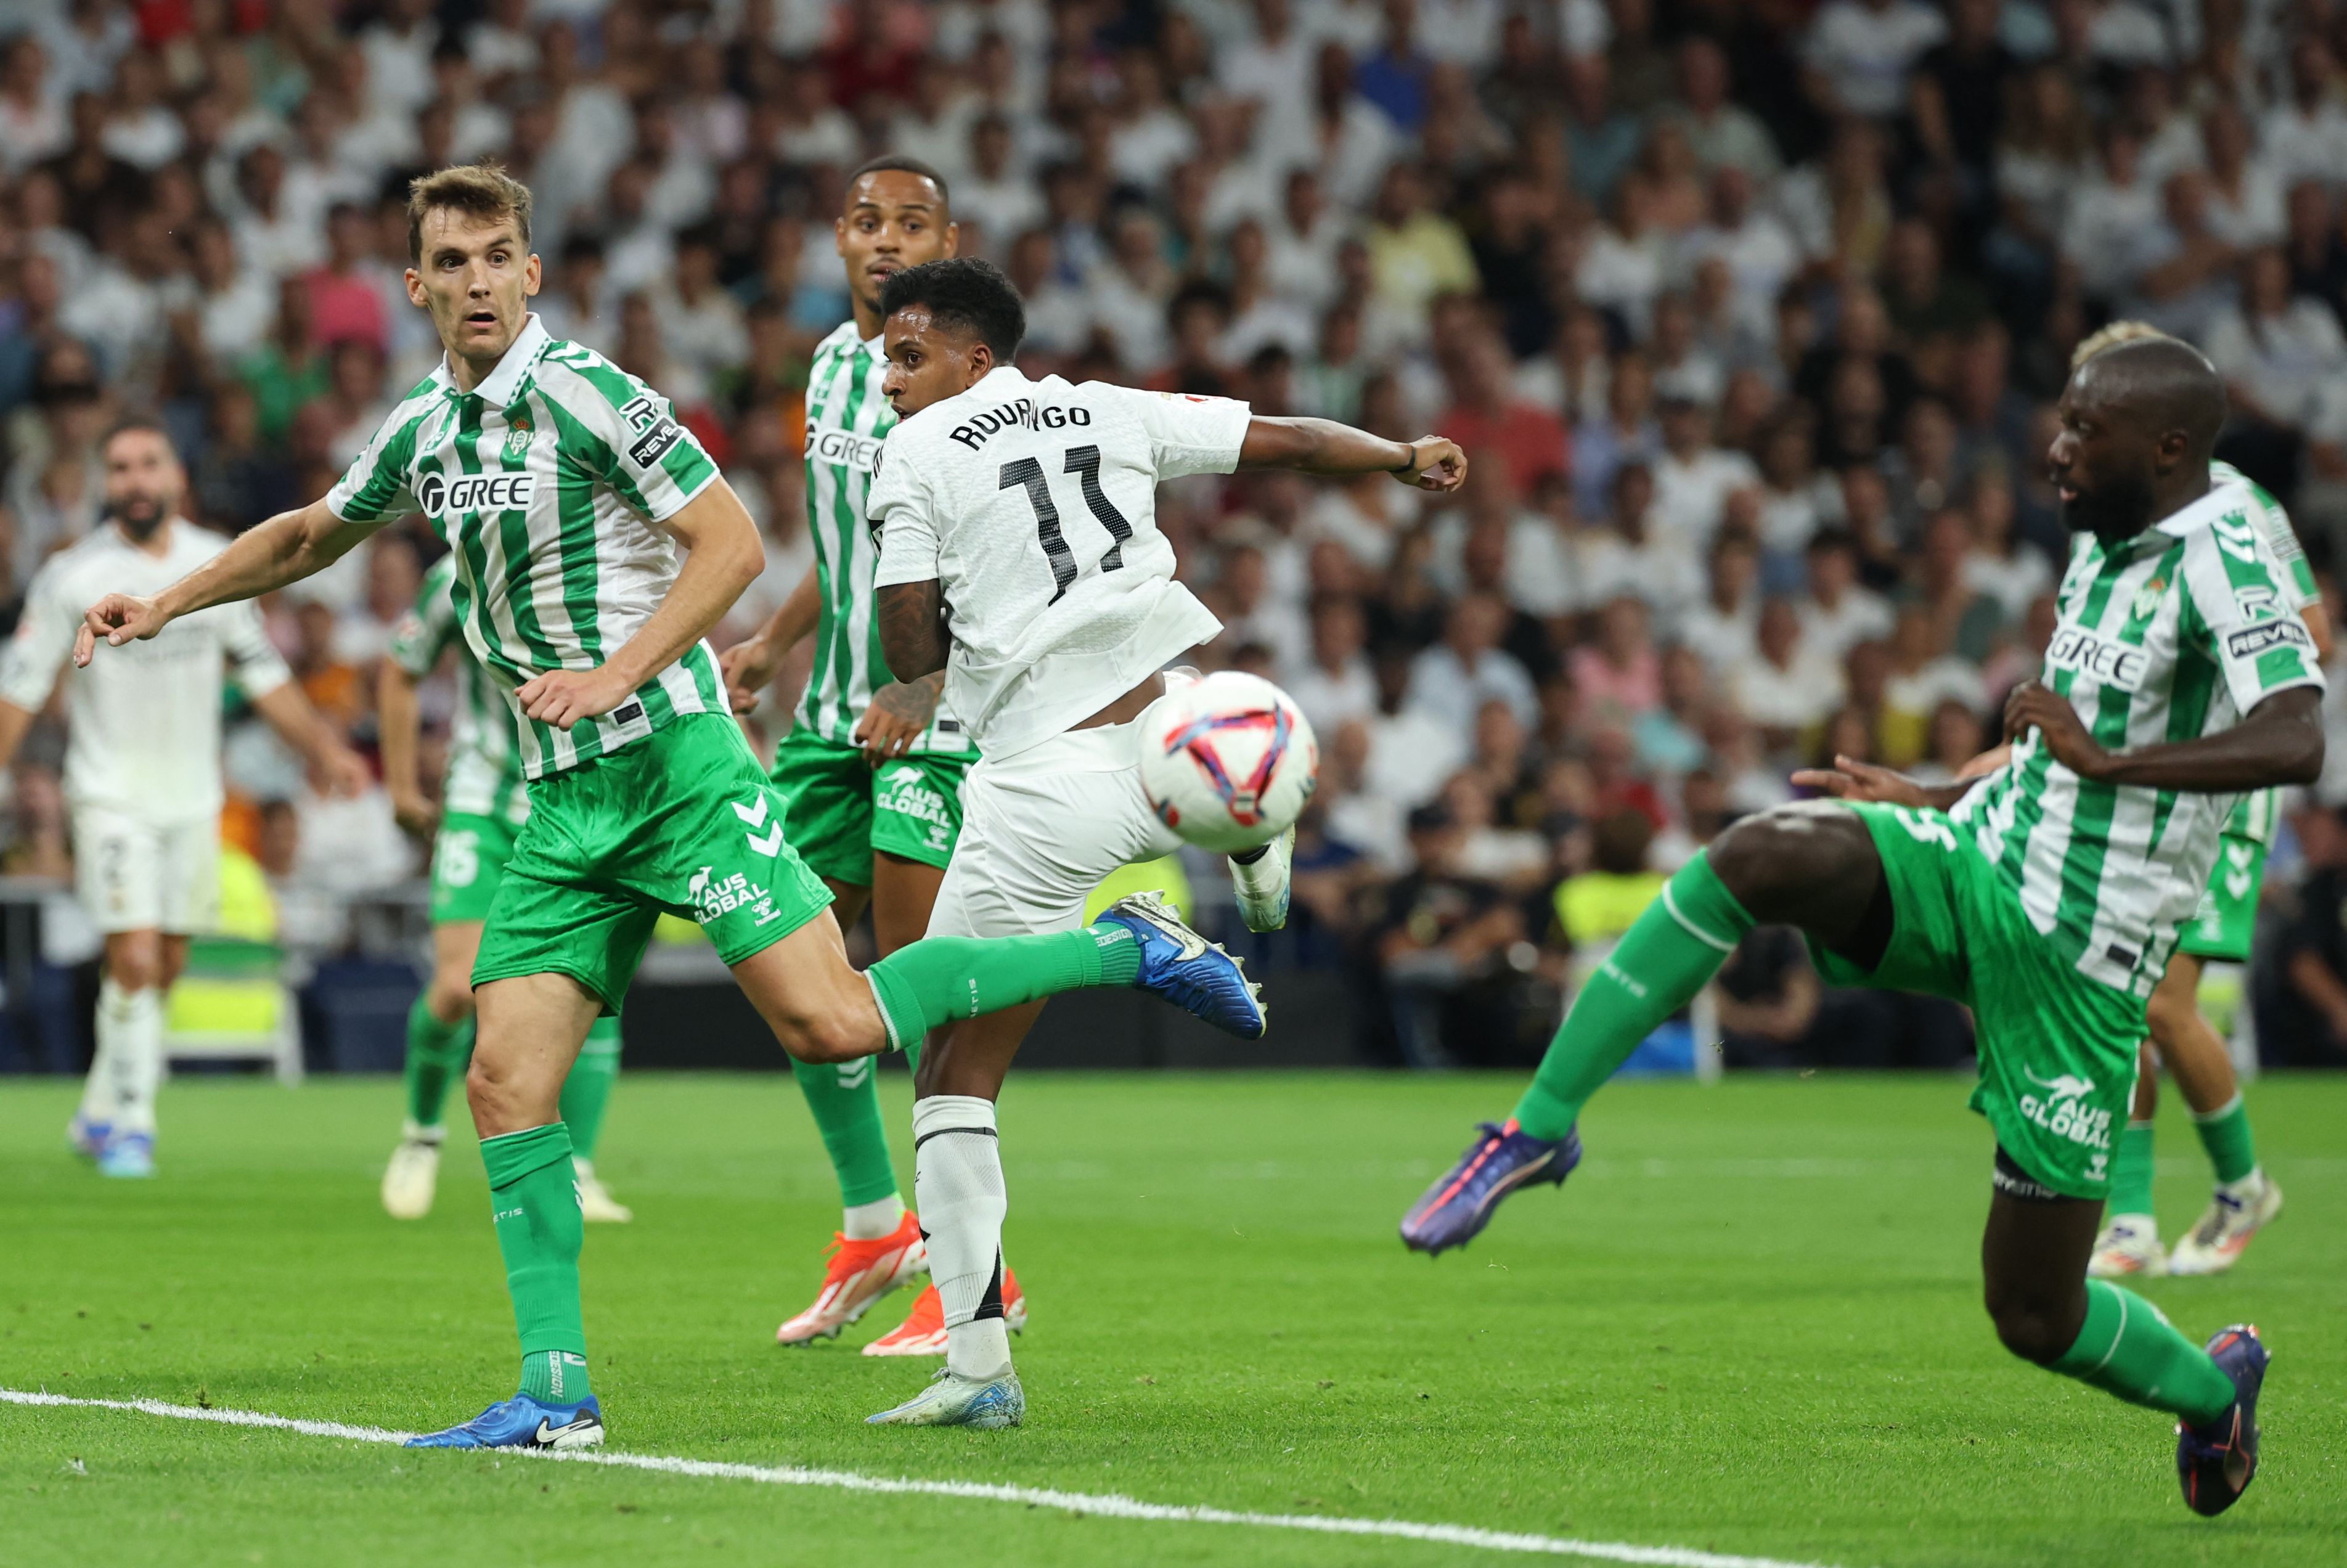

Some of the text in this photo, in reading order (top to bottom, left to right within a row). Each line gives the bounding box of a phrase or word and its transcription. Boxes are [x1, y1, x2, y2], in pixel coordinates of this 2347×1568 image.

[635, 425, 678, 463] REVEL
[820, 433, 875, 466] GRE
[449, 476, 533, 508] GREE
[998, 444, 1133, 608] 11
[2051, 630, 2145, 685] GREE
[876, 791, 952, 828] GLOBAL
[898, 783, 944, 810] AUS
[704, 872, 747, 906] AUS
[2020, 1094, 2110, 1149] GLOBAL
[2057, 1098, 2112, 1130] AUS
